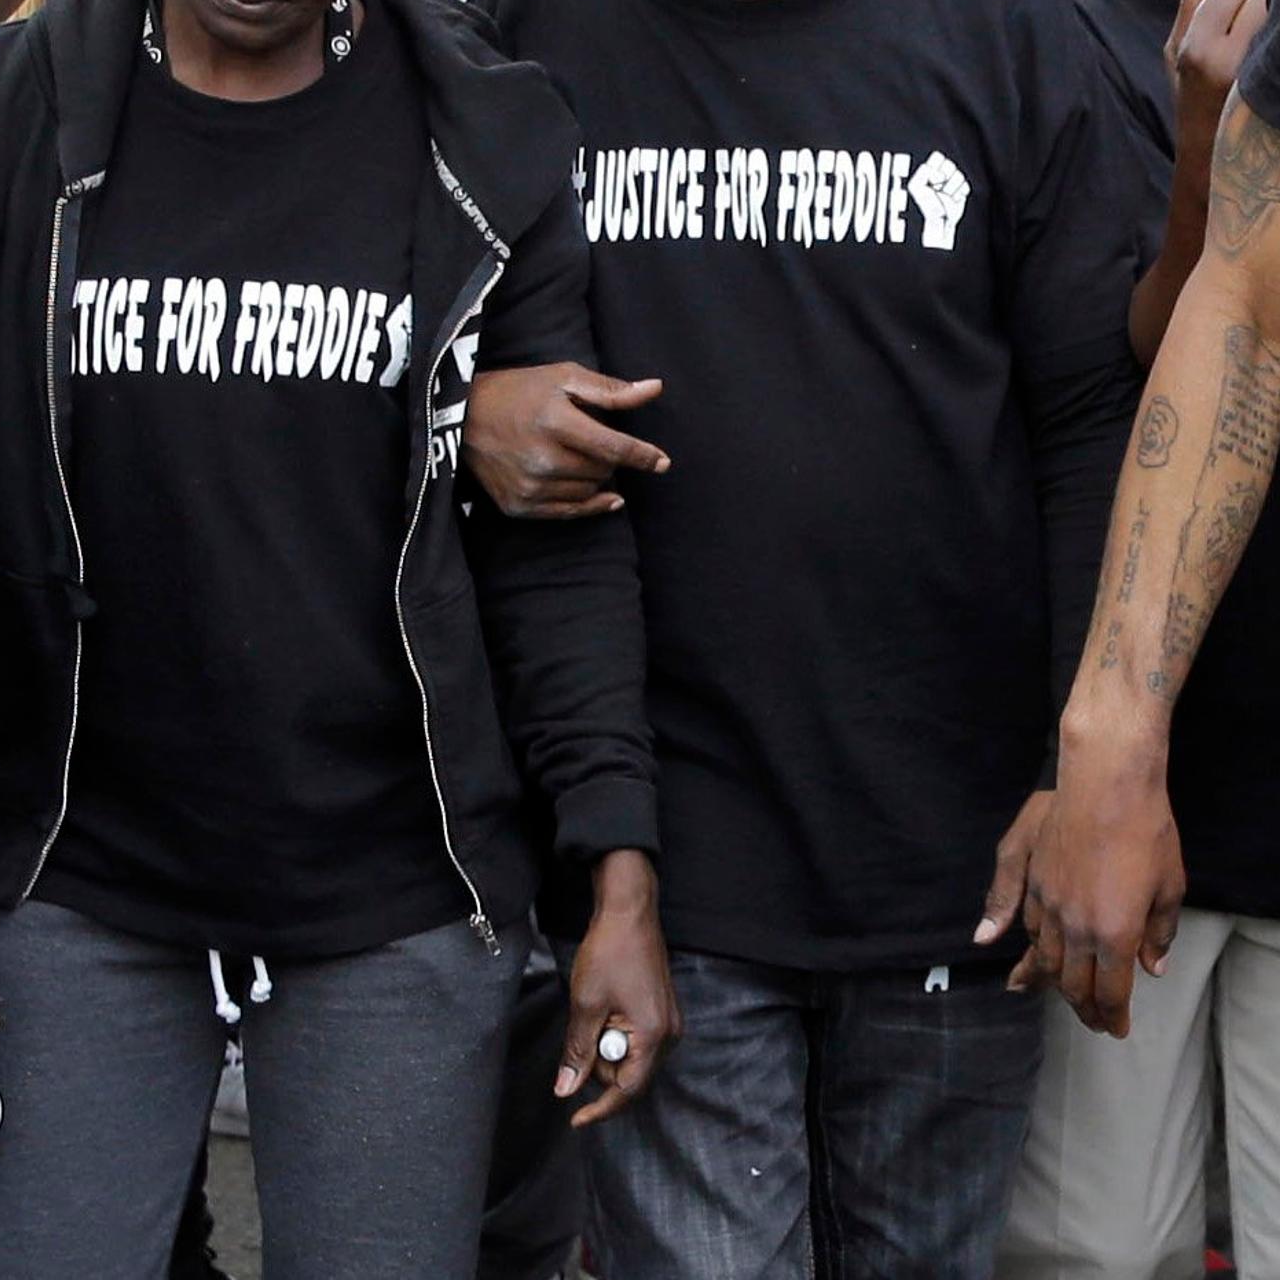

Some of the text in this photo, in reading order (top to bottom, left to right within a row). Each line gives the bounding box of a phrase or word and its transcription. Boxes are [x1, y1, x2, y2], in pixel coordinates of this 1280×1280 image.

[715, 147, 769, 248] FOR
[776, 148, 911, 249] FREDDIE
[156, 277, 228, 383] FOR
[232, 280, 389, 384] FREDDIE
